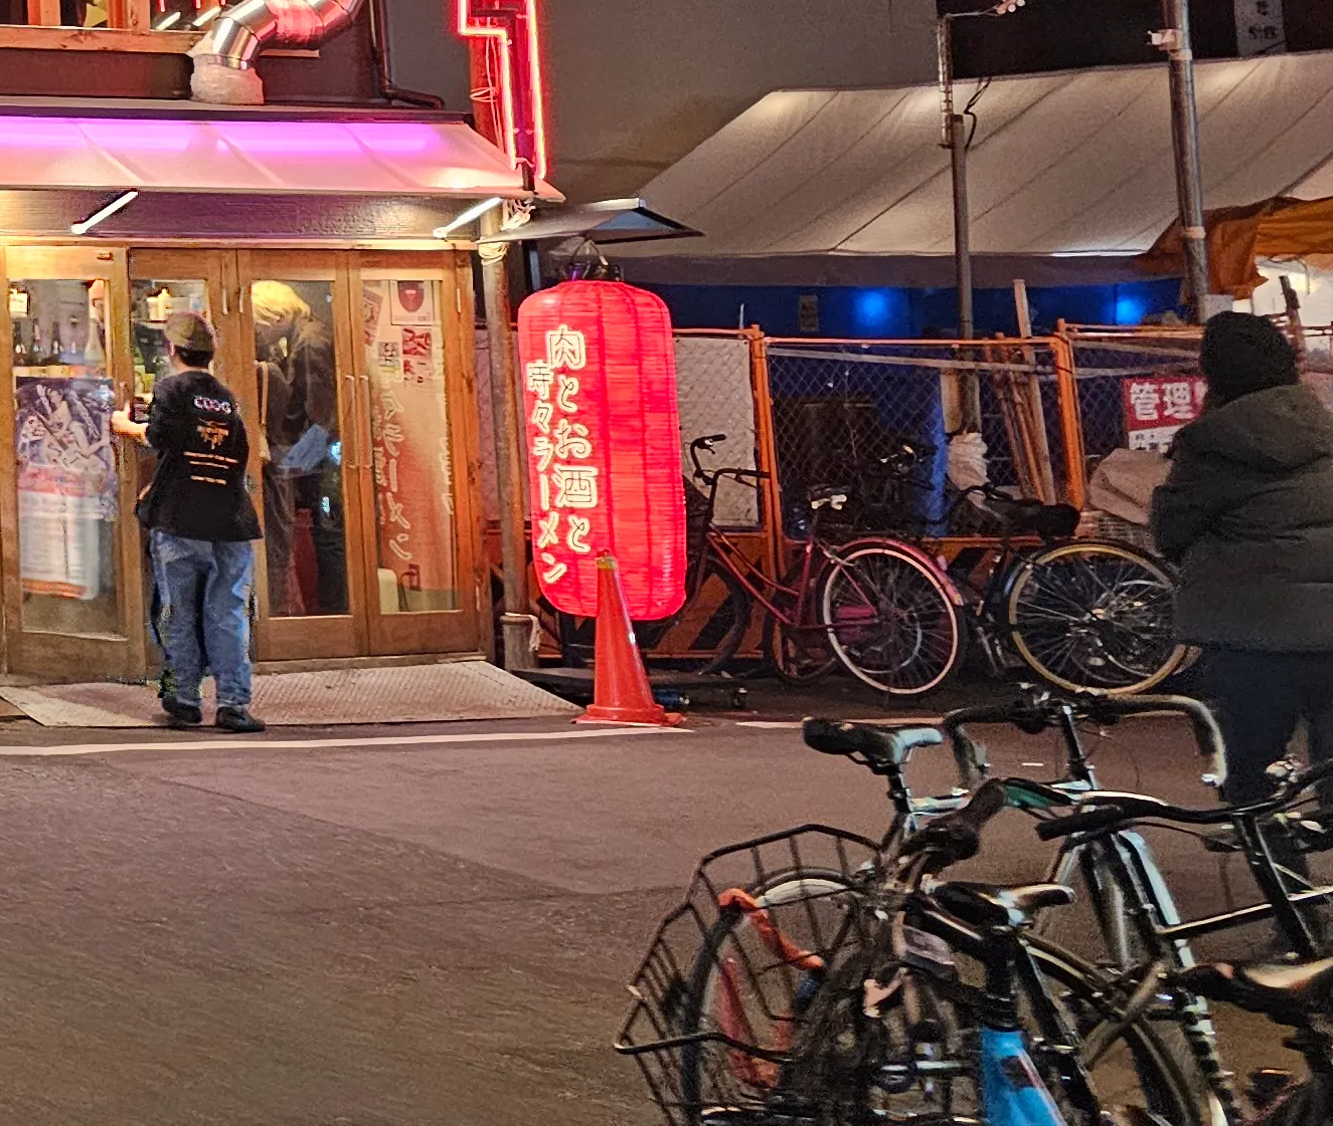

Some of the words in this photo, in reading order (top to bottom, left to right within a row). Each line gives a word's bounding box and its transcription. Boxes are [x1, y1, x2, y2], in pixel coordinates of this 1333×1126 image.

[546, 325, 599, 553] 肉とお酒と
[1129, 381, 1208, 421] 管理
